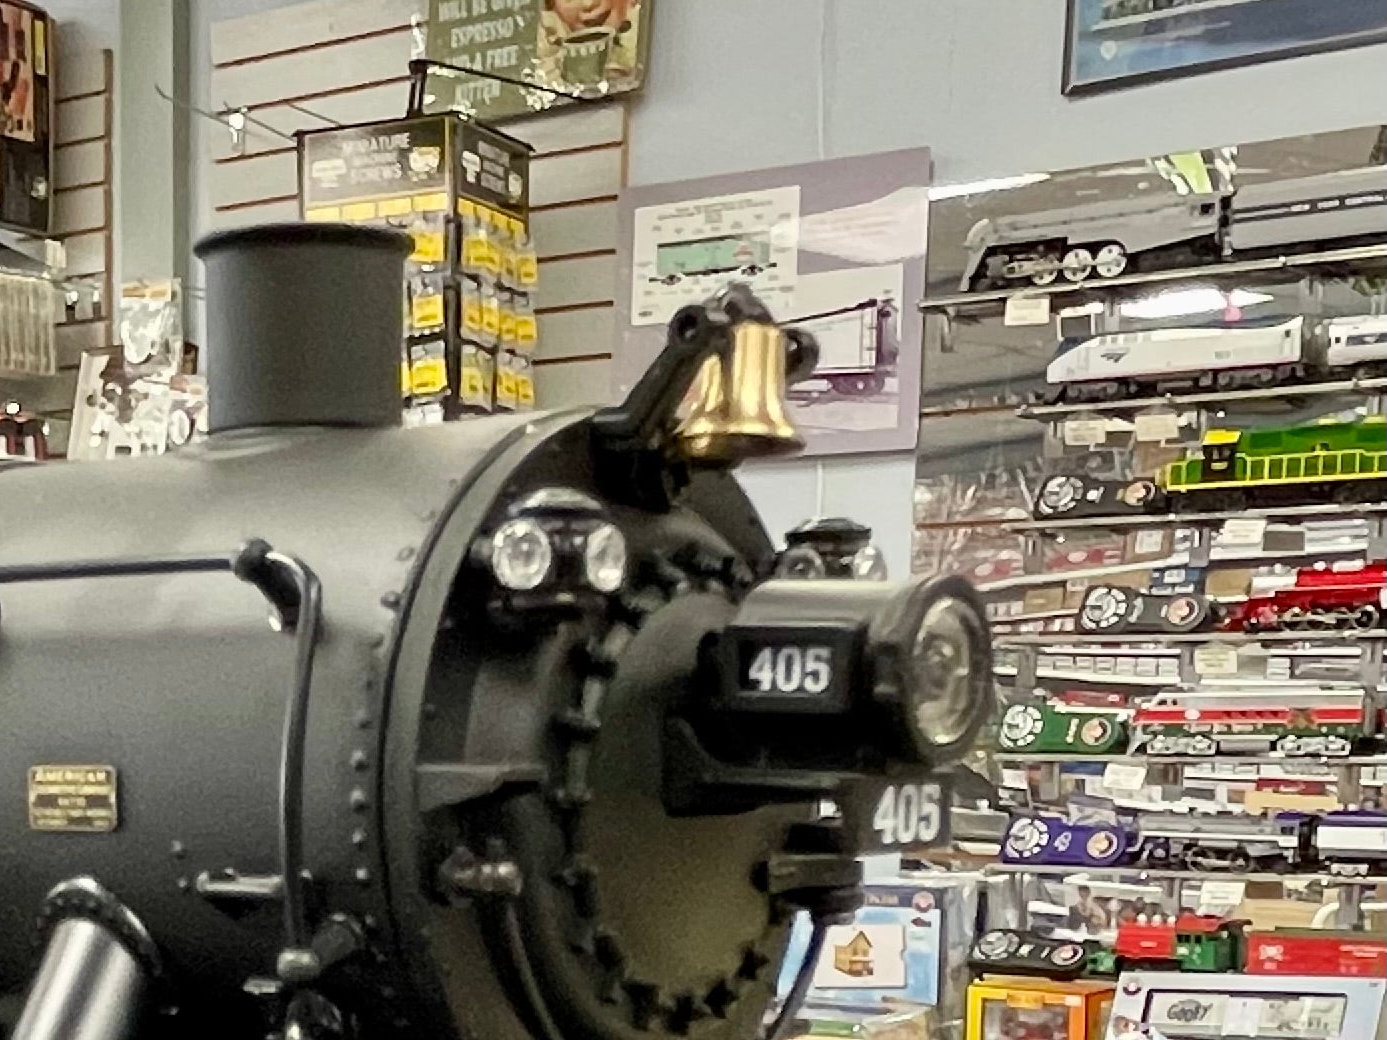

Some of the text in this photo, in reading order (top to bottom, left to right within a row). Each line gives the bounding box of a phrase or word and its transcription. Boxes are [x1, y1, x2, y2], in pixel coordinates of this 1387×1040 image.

[450, 16, 514, 48] ESPRESSO
[748, 645, 832, 694] 405
[873, 783, 942, 844] 405
